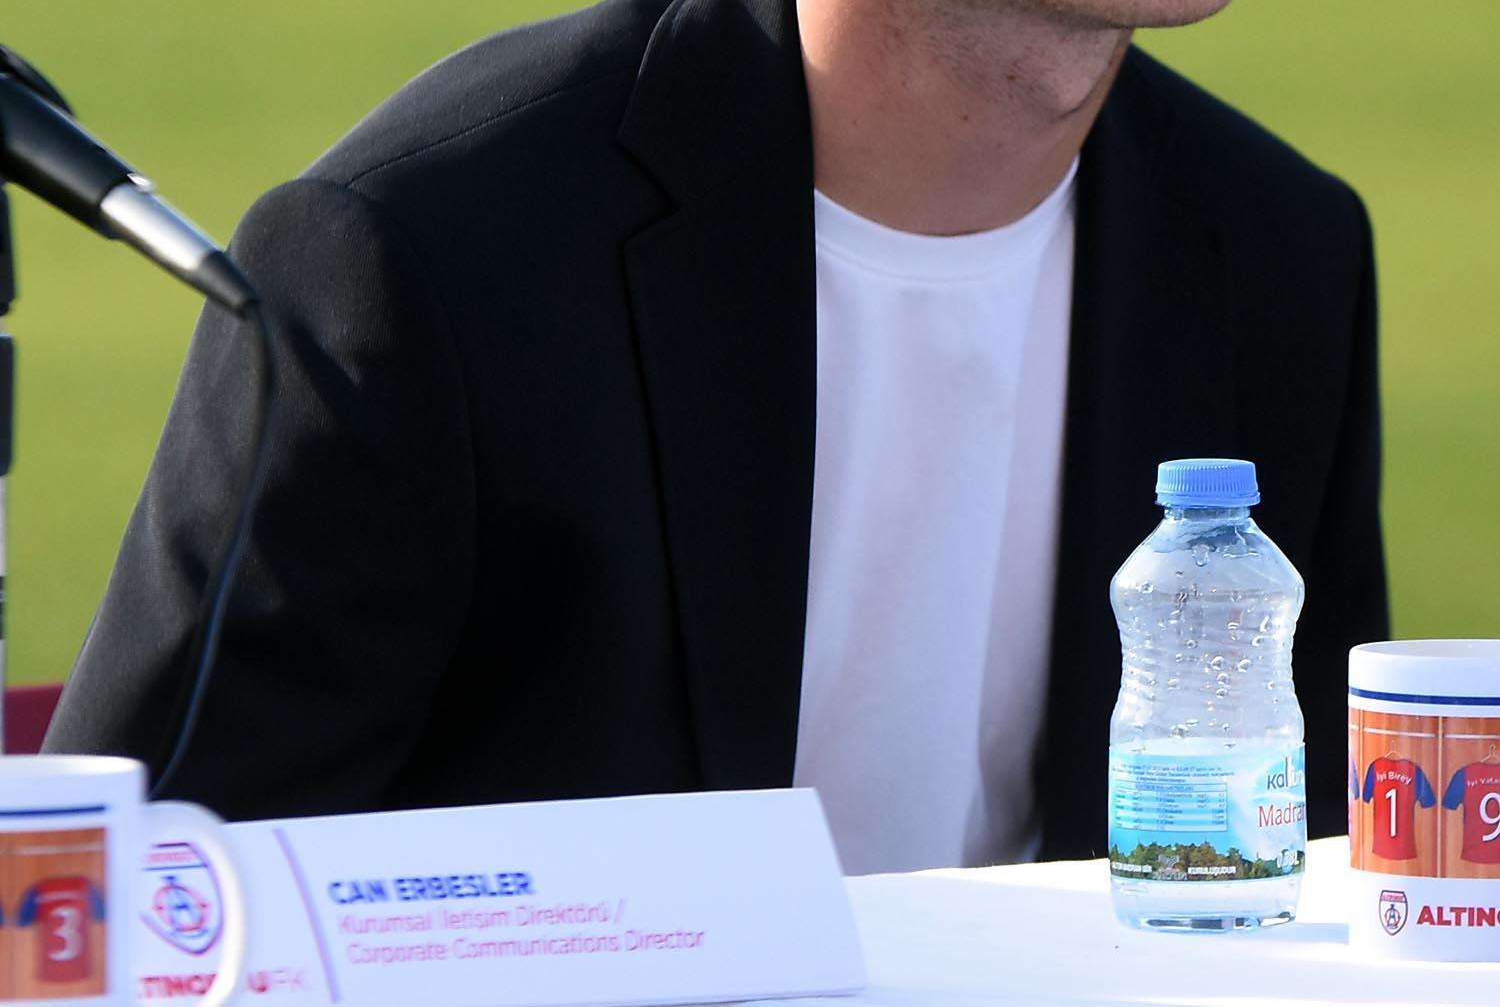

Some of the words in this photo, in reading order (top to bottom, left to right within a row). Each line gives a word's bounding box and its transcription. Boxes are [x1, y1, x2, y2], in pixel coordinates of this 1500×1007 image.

[1385, 788, 1397, 838] 1
[329, 879, 390, 905] CAN
[48, 905, 82, 961] 3
[347, 942, 450, 967] Corporate
[452, 933, 620, 960] Communications
[624, 929, 706, 952] Director
